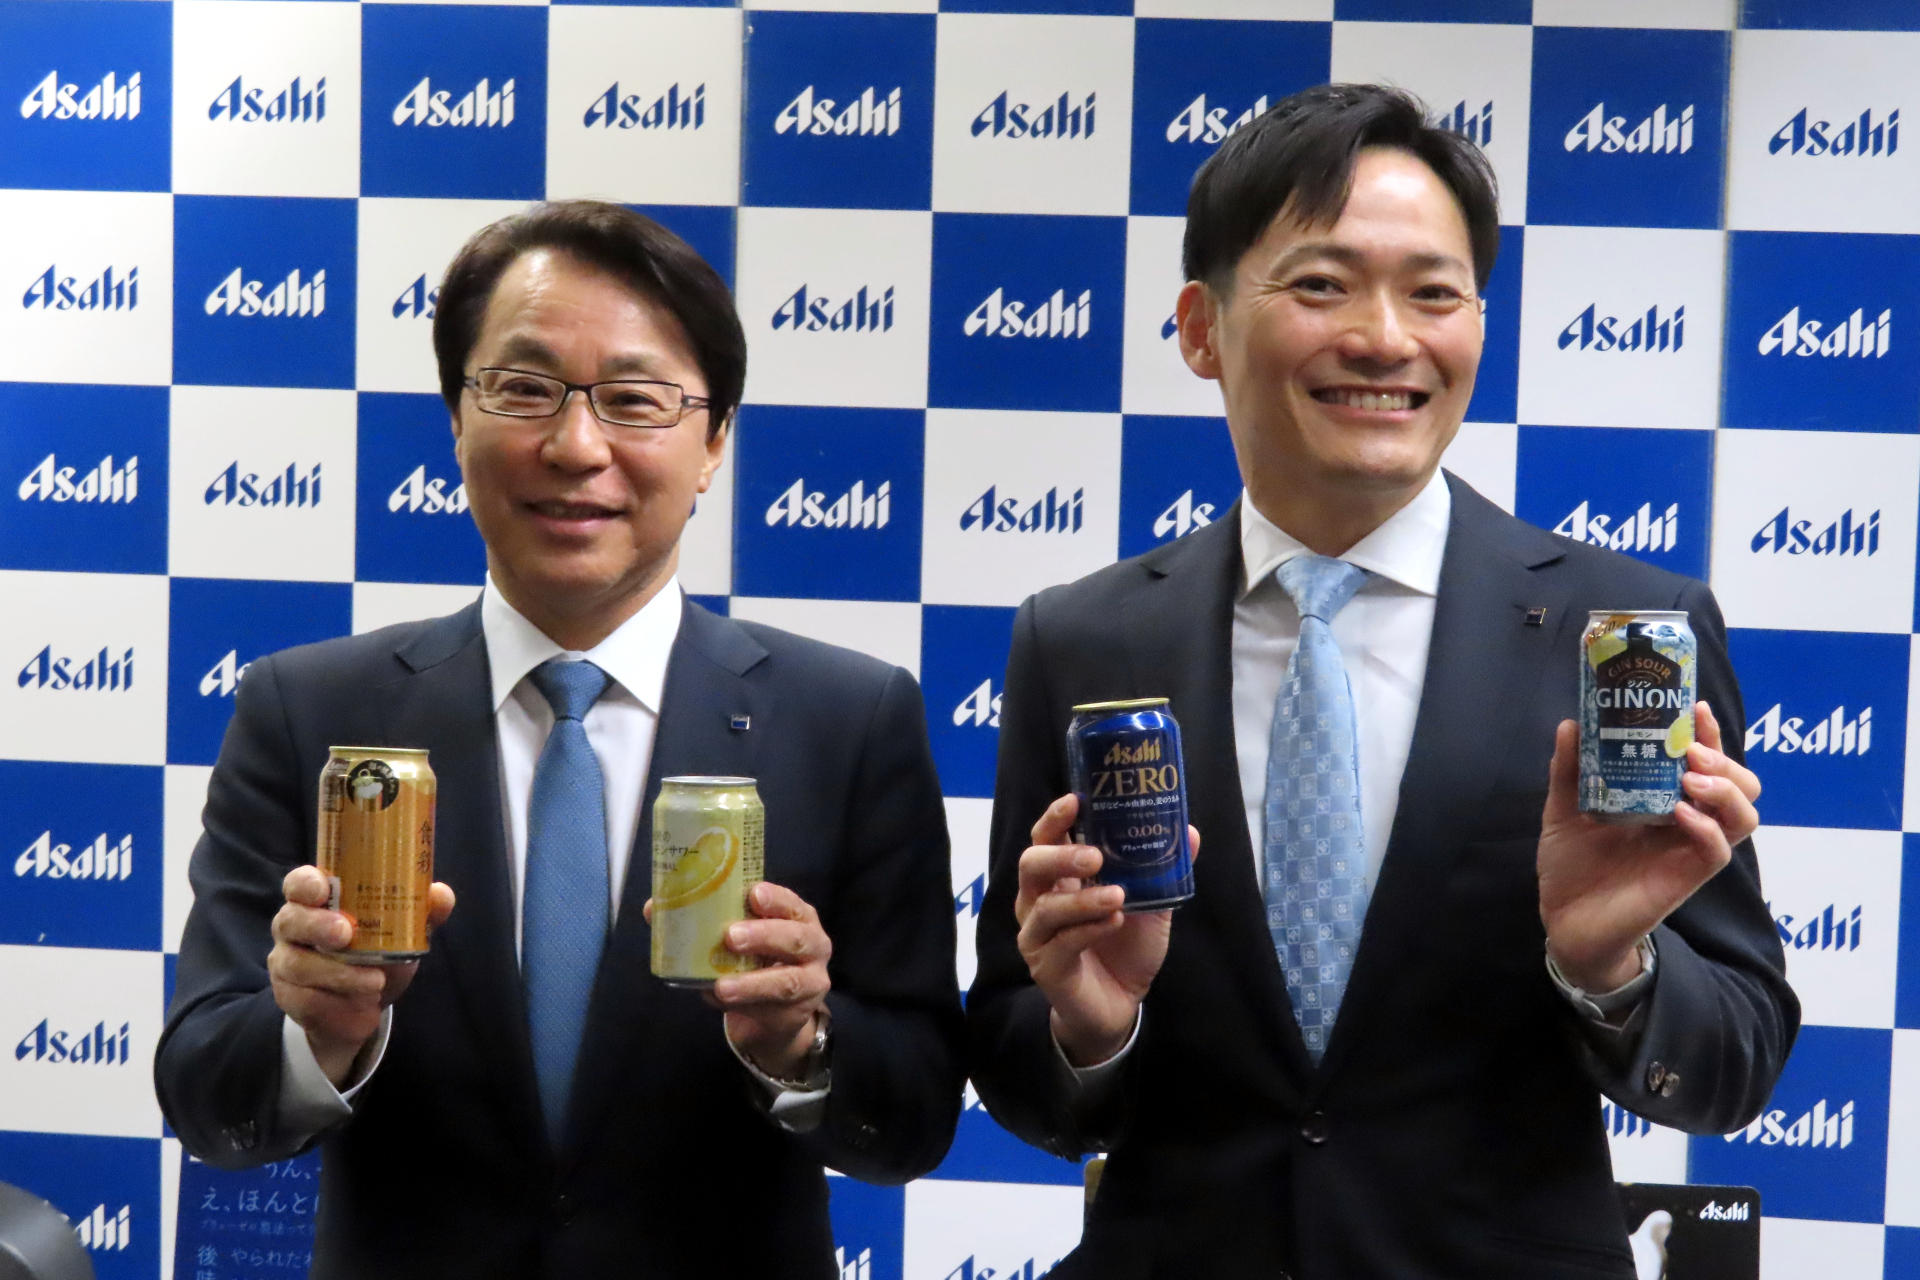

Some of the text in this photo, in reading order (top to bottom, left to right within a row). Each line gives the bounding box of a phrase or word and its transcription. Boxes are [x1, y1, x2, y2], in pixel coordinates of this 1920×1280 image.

[20, 70, 141, 121] Asahi
[208, 76, 326, 123] Asahi
[392, 76, 515, 128] Asahi
[583, 82, 705, 130] Asahi
[774, 85, 901, 137] Asahi
[970, 91, 1096, 139] Asahi
[1563, 102, 1694, 155] Asahi
[1768, 107, 1899, 157] Asahi
[22, 265, 138, 311] Asahi
[204, 267, 326, 318] Asahi
[771, 284, 894, 333] Asahi
[963, 287, 1091, 339] Asahi
[1557, 303, 1685, 353] Asahi
[1758, 306, 1891, 359] Asahi
[18, 453, 138, 504] Asahi
[204, 461, 321, 508] Asahi
[388, 465, 469, 514] Asa
[765, 477, 890, 530] Asahi
[959, 485, 1083, 534] Asahi
[1750, 506, 1880, 557] Asahi
[17, 645, 133, 691] Asahi
[1608, 658, 1671, 679] GIN SOUR
[1595, 688, 1682, 709] GINON
[1104, 737, 1161, 766] Asahi
[1621, 743, 1658, 759] 無糖
[1744, 703, 1872, 756] Asahi
[1092, 764, 1179, 798] ZERO
[14, 830, 133, 881] Asahi
[1766, 901, 1862, 952] sahi
[15, 1018, 129, 1065] Asahi
[1699, 1200, 1749, 1221] Asahi
